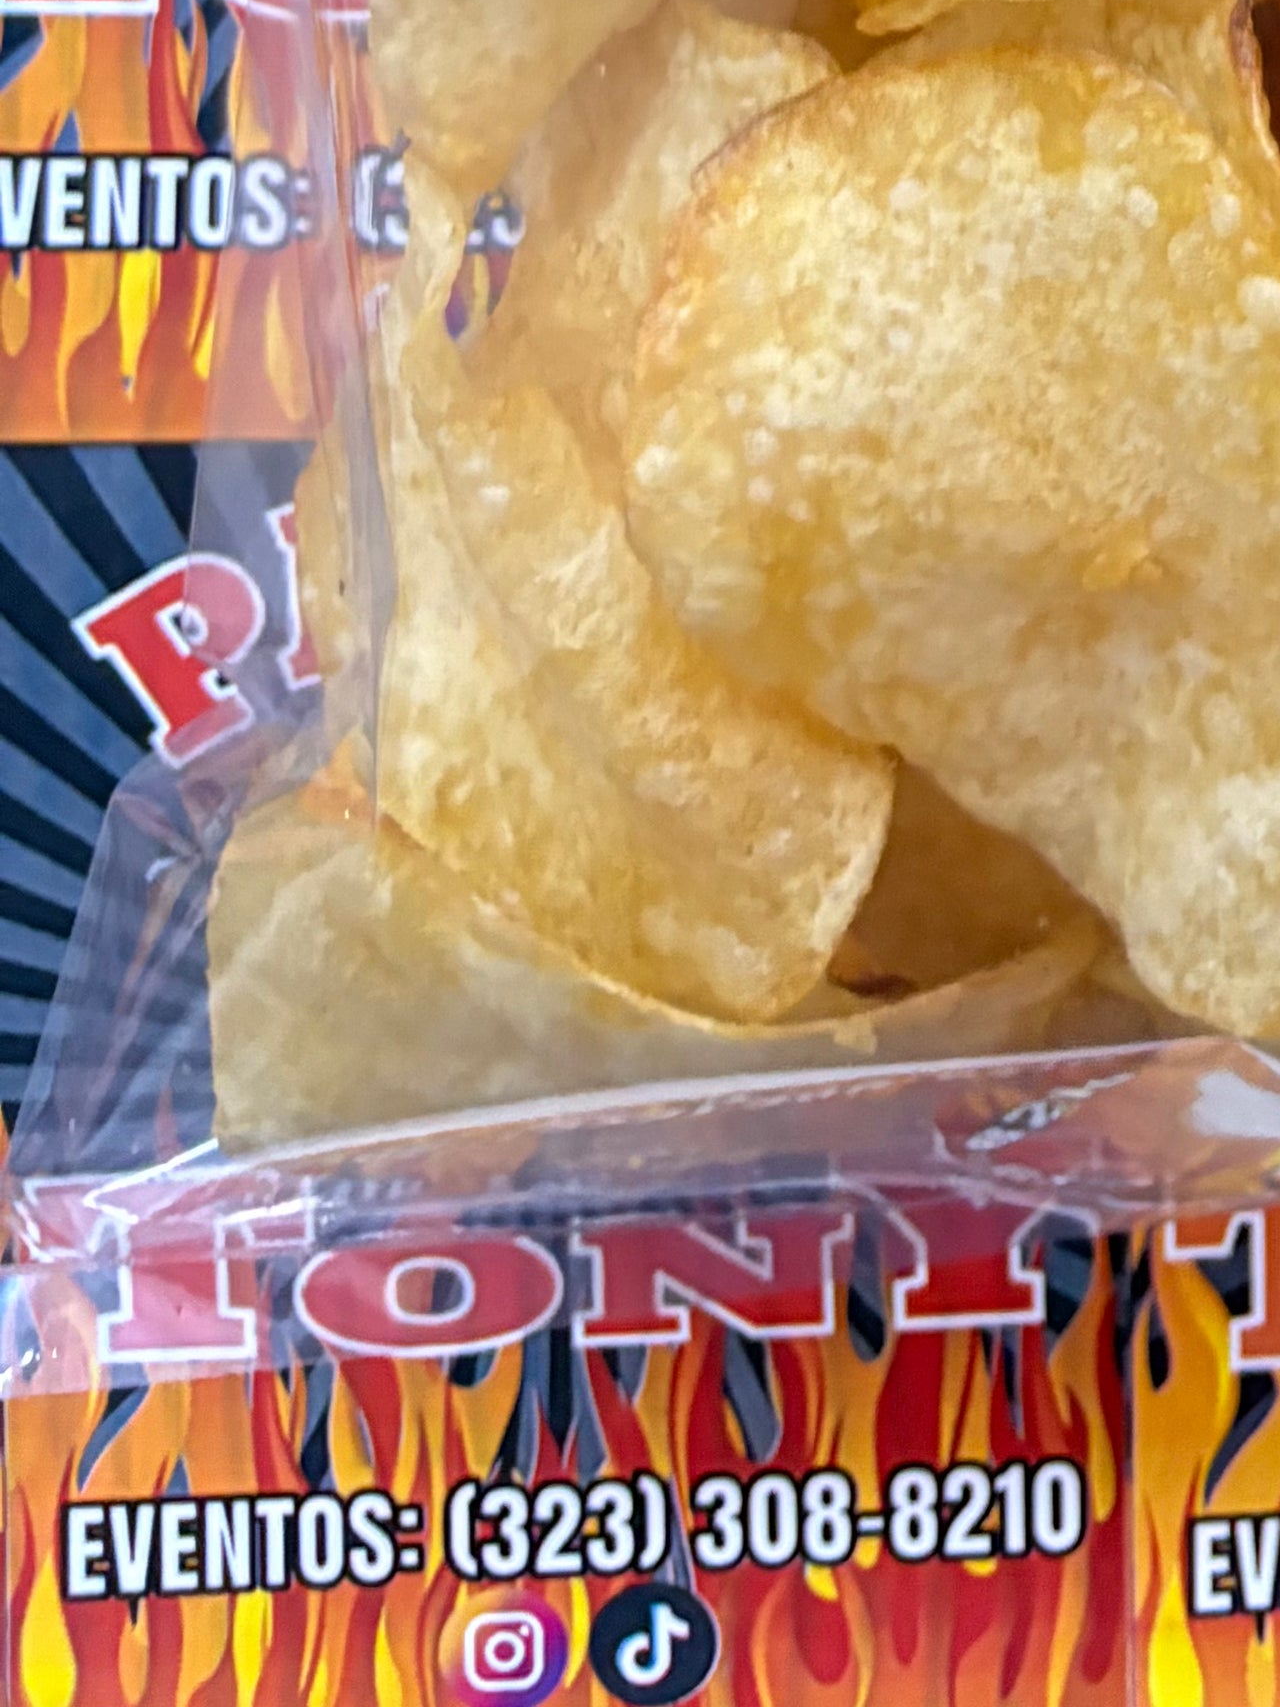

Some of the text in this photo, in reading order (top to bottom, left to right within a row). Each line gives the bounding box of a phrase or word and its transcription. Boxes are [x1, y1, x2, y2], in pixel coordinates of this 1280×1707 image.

[66, 1462, 1085, 1599] EVENTOS: (323) 308-8210
